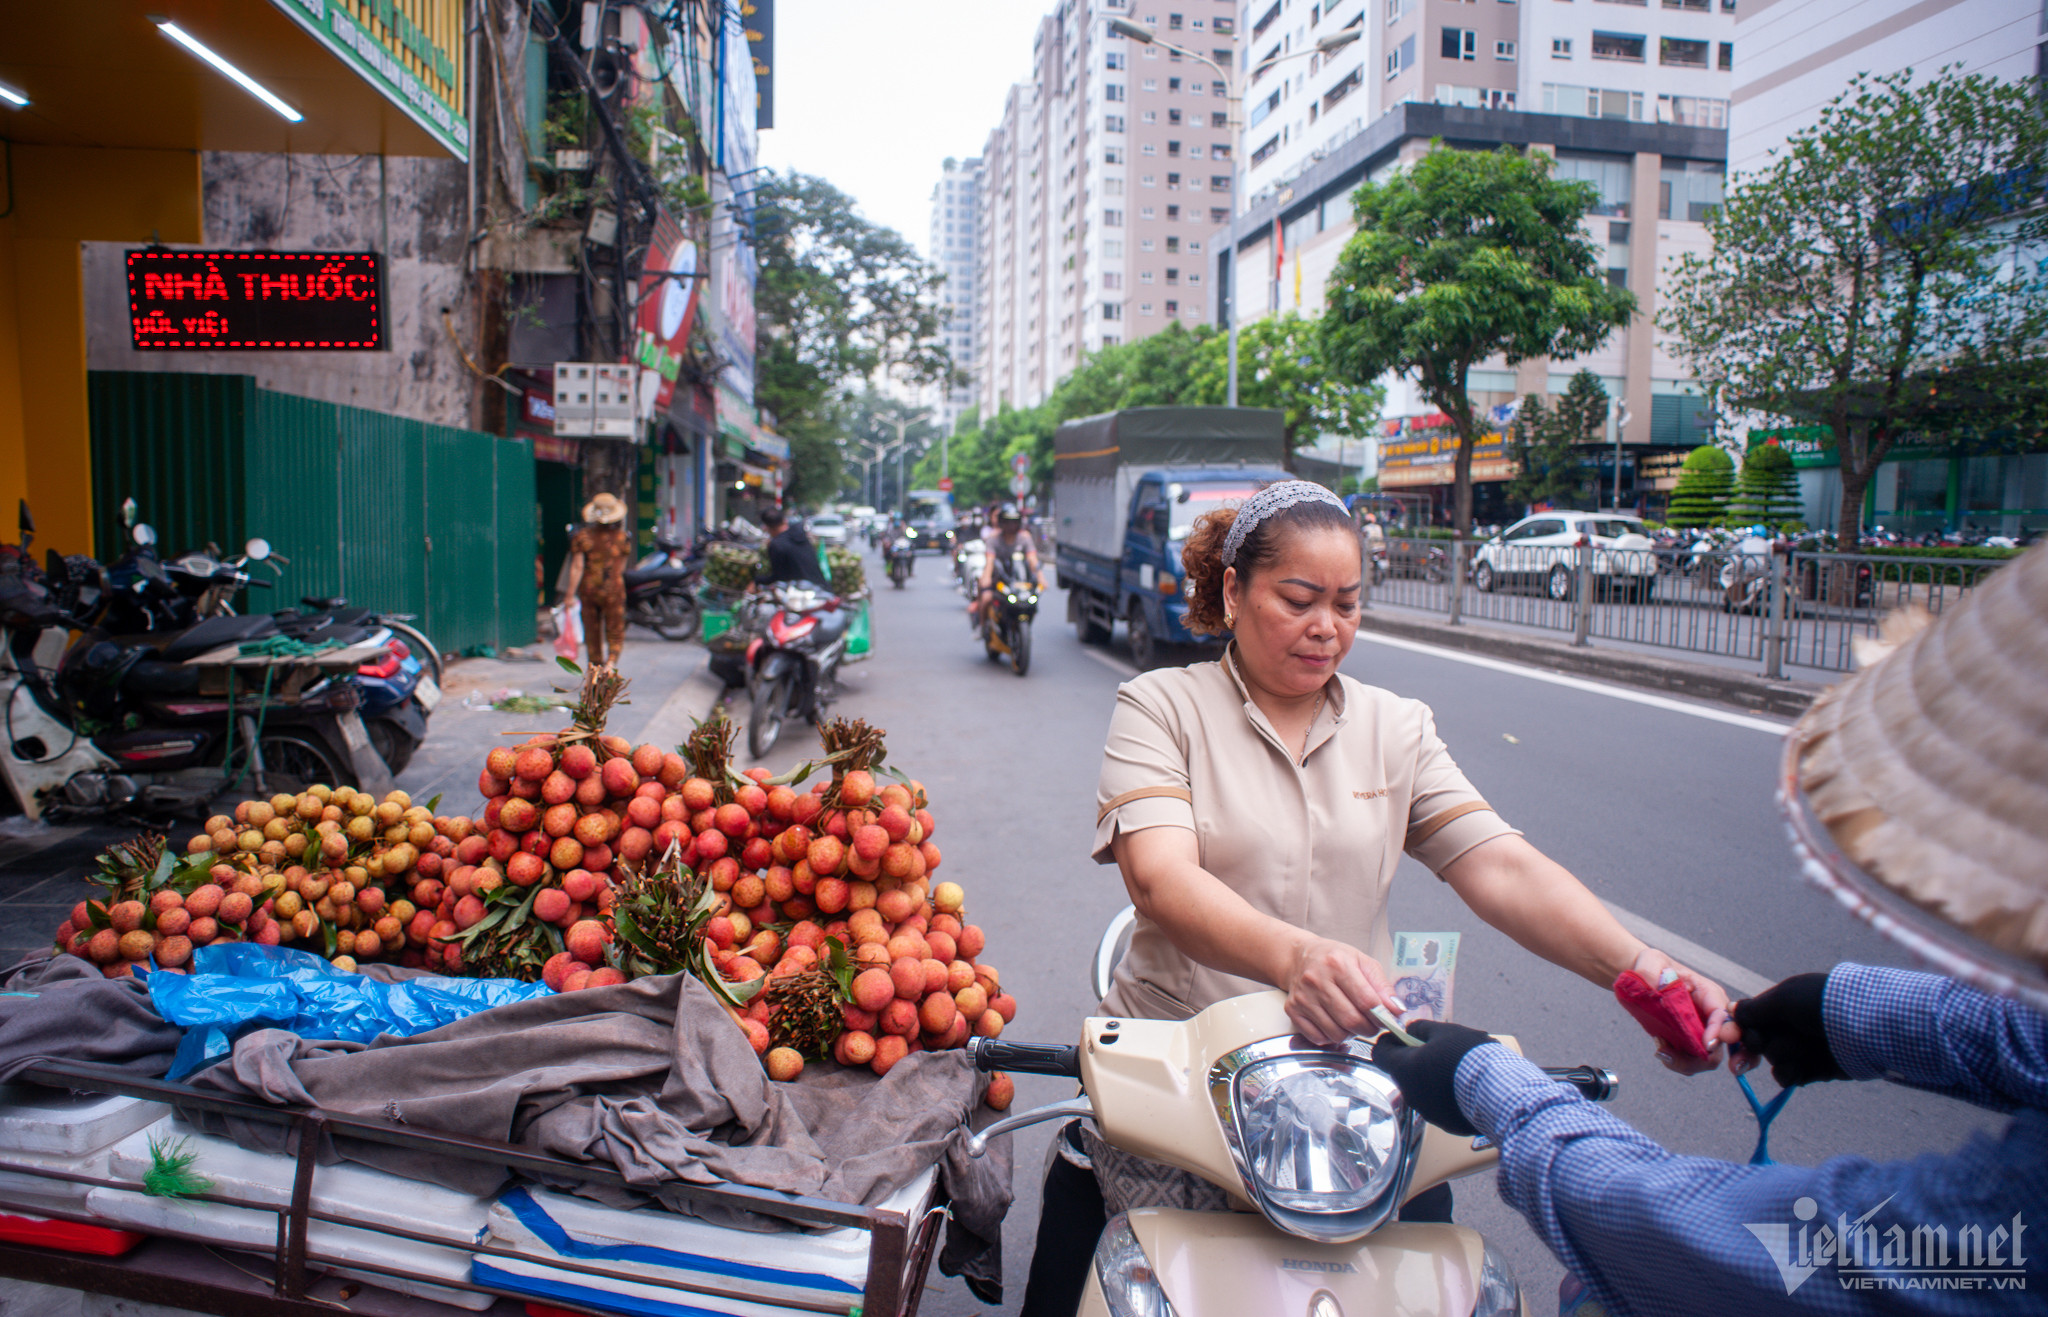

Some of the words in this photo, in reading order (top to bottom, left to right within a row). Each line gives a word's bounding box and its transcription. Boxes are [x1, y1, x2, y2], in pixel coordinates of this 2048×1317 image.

[145, 261, 229, 300] NHÀ
[237, 262, 368, 301] THUỐC
[1281, 1258, 1359, 1274] HONDA
